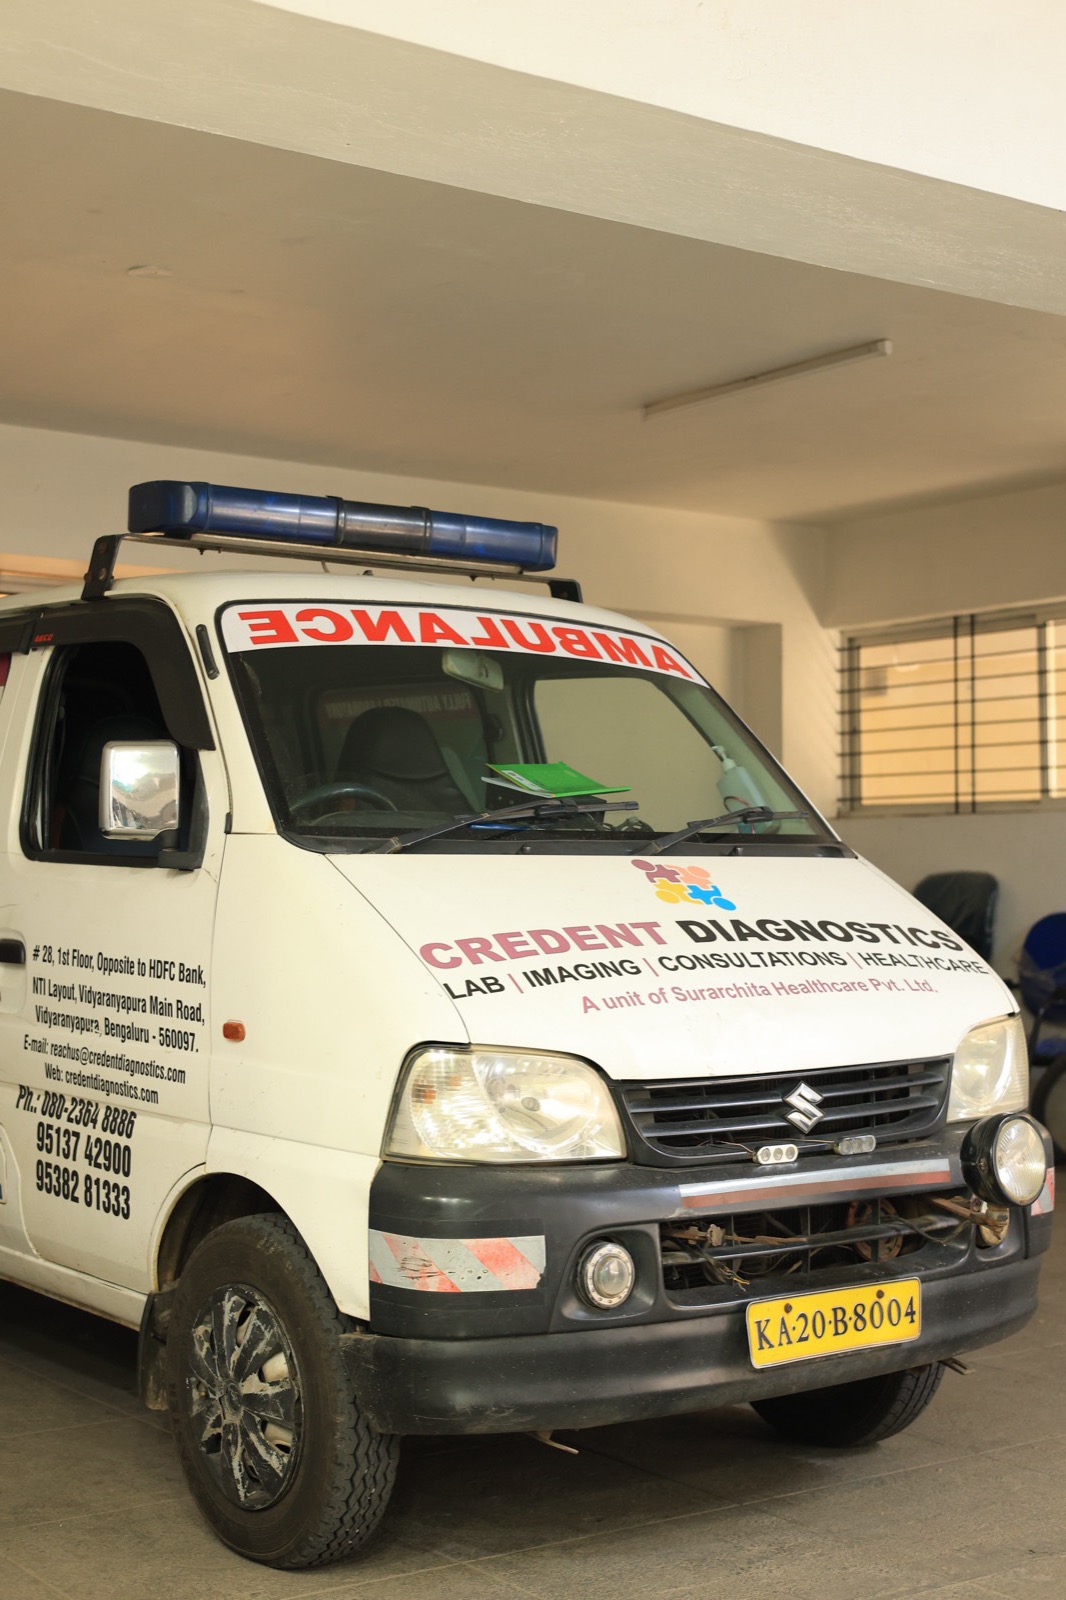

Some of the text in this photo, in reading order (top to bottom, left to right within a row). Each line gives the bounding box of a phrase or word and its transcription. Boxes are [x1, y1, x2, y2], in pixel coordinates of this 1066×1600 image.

[42, 945, 55, 966] 28,
[57, 948, 70, 967] 1st
[71, 949, 95, 973] Floor,
[97, 951, 135, 976] Opposite
[137, 958, 147, 978] to
[149, 958, 176, 981] HDFC
[178, 963, 207, 989] Bank,
[419, 919, 964, 970] CREDENT DIAGNOSTICS
[443, 952, 989, 999] LAB IMAGING CONSULTATIONS HEALTHCARE
[582, 978, 939, 1014] A unit of Surarchita Healthcare Pvt. Ltd.
[32, 976, 206, 1026] NTI Layout, Vidyaranyapura Main Road,
[35, 1005, 103, 1038] Vidyaranyapura,
[104, 1017, 150, 1044] Bengaluru
[158, 1027, 200, 1053] 560097.
[23, 1034, 187, 1085] E-mail: reachus@credentdiagnostics.com
[44, 1062, 160, 1105] Web: credentdiagnostics.com
[15, 1084, 138, 1140] Ph.: 080-2364 8886
[36, 1121, 132, 1178] 95137 42900
[36, 1159, 131, 1220] 95382 81333
